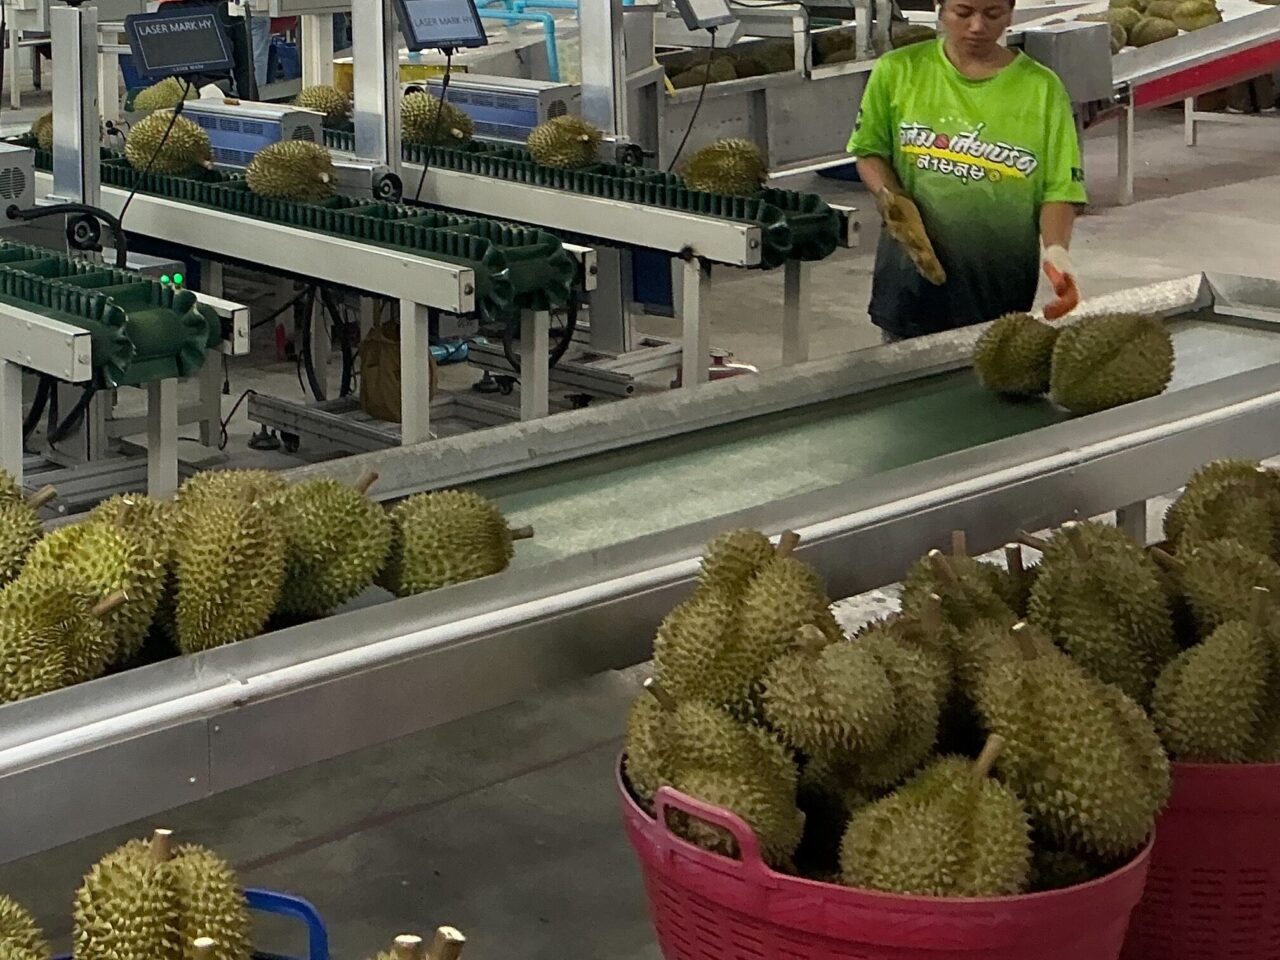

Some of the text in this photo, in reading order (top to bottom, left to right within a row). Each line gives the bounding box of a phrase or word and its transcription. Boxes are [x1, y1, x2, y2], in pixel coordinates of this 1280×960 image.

[138, 20, 212, 36] LASER MARK HY
